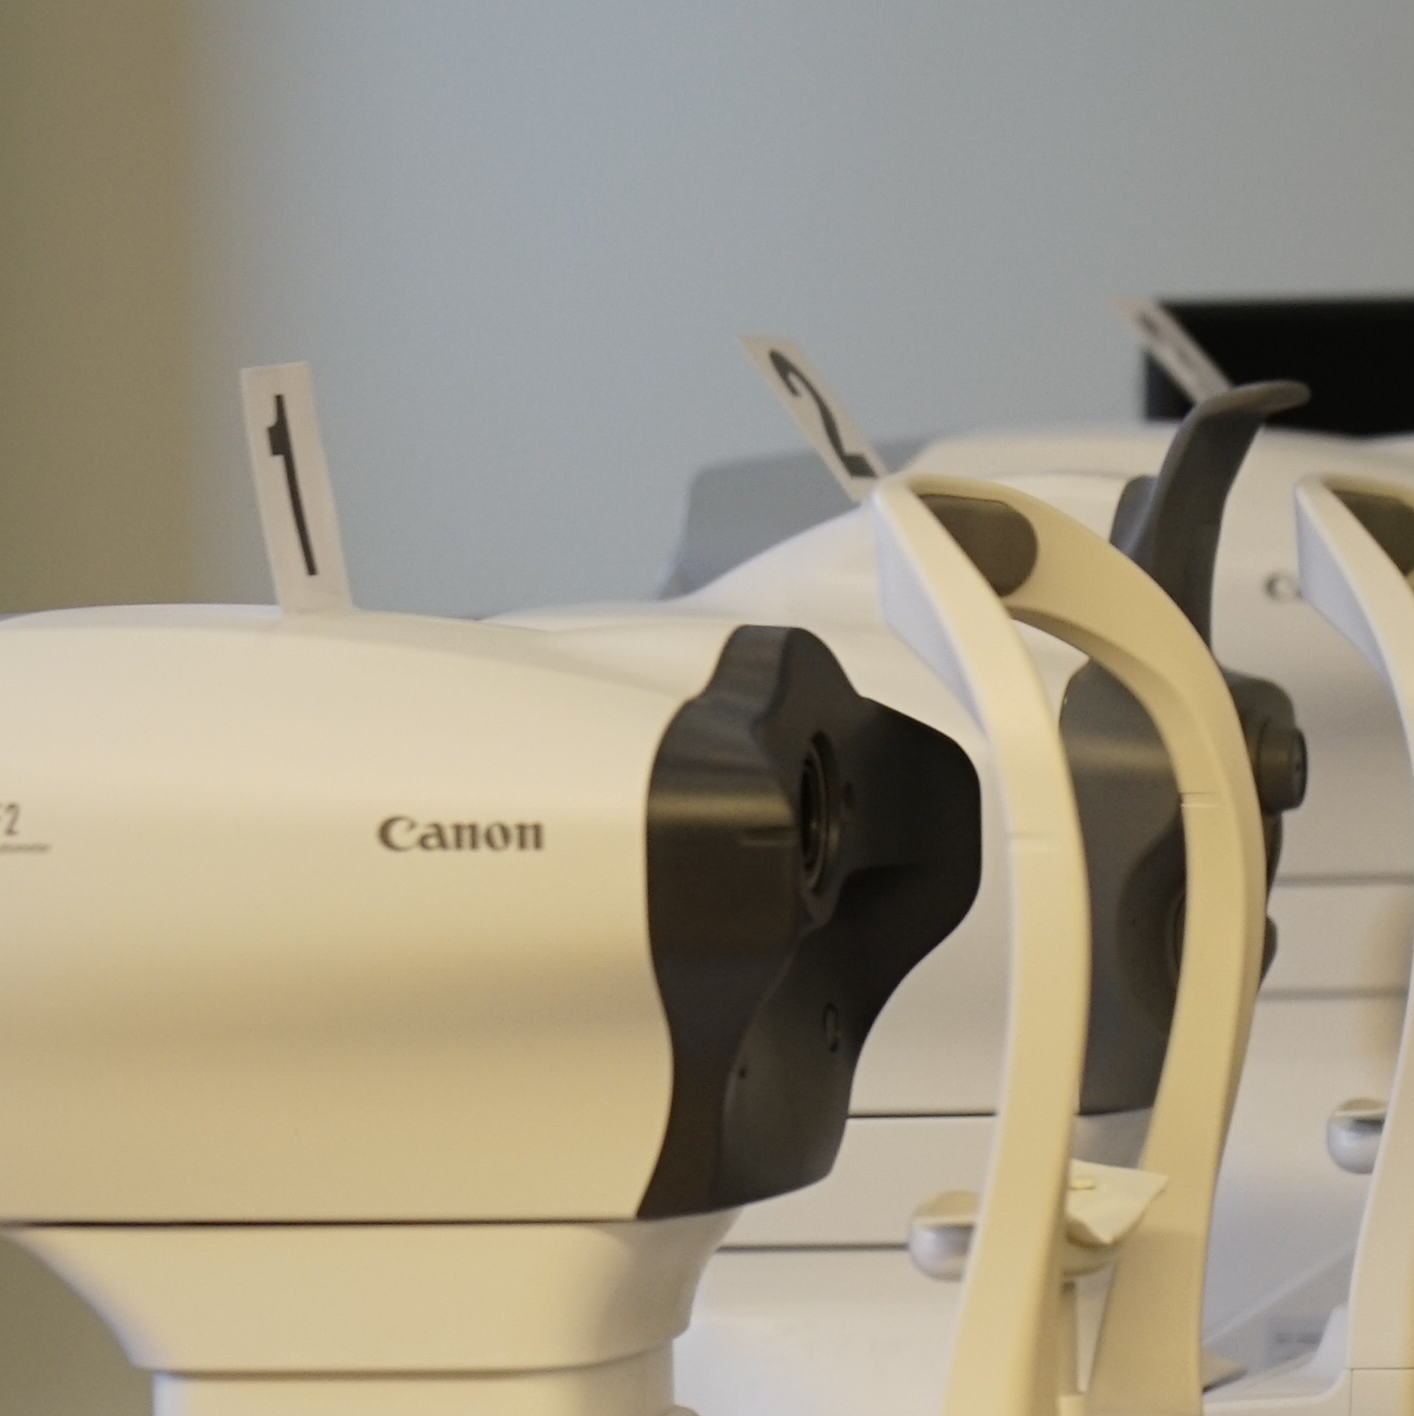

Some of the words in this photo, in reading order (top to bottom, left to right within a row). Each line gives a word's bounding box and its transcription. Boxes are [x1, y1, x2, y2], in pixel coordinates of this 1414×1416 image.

[768, 349, 879, 480] 2
[267, 394, 318, 576] 1
[378, 815, 544, 852] Canon
